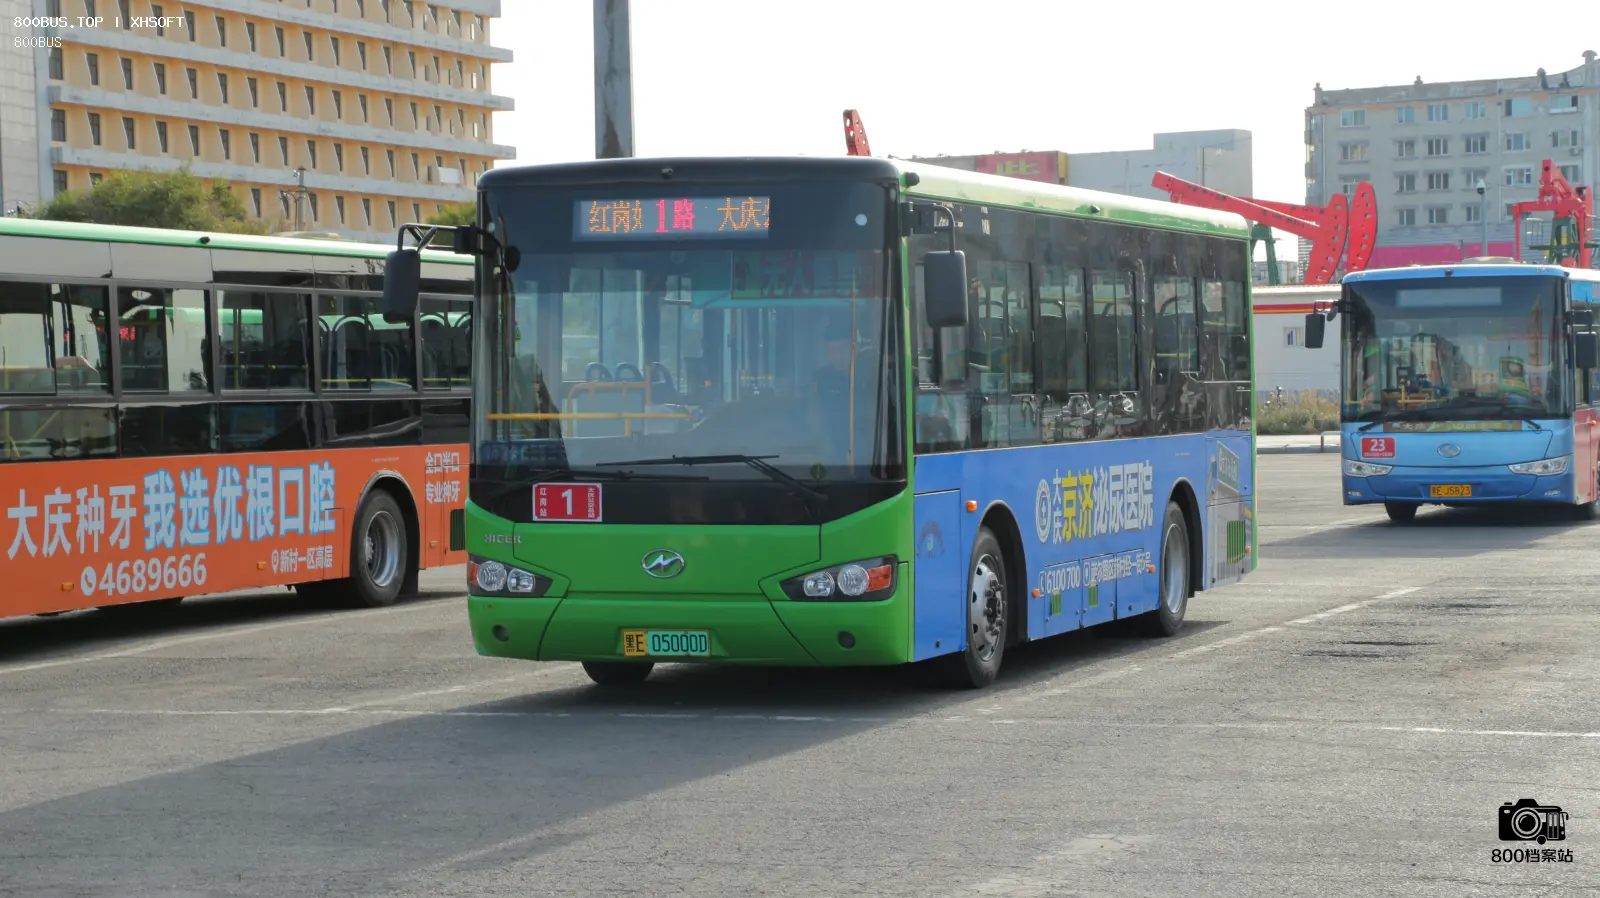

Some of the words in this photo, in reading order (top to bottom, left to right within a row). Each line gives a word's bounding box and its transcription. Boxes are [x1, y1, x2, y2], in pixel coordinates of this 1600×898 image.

[1370, 438, 1385, 452] 23
[425, 451, 460, 474] 全口半口
[425, 480, 461, 504] 专业种牙
[561, 488, 573, 515] 1
[484, 533, 522, 544] HIGER
[280, 545, 333, 573] 新村一区高层
[99, 553, 207, 596] 4689666
[1047, 565, 1081, 594] 6100700
